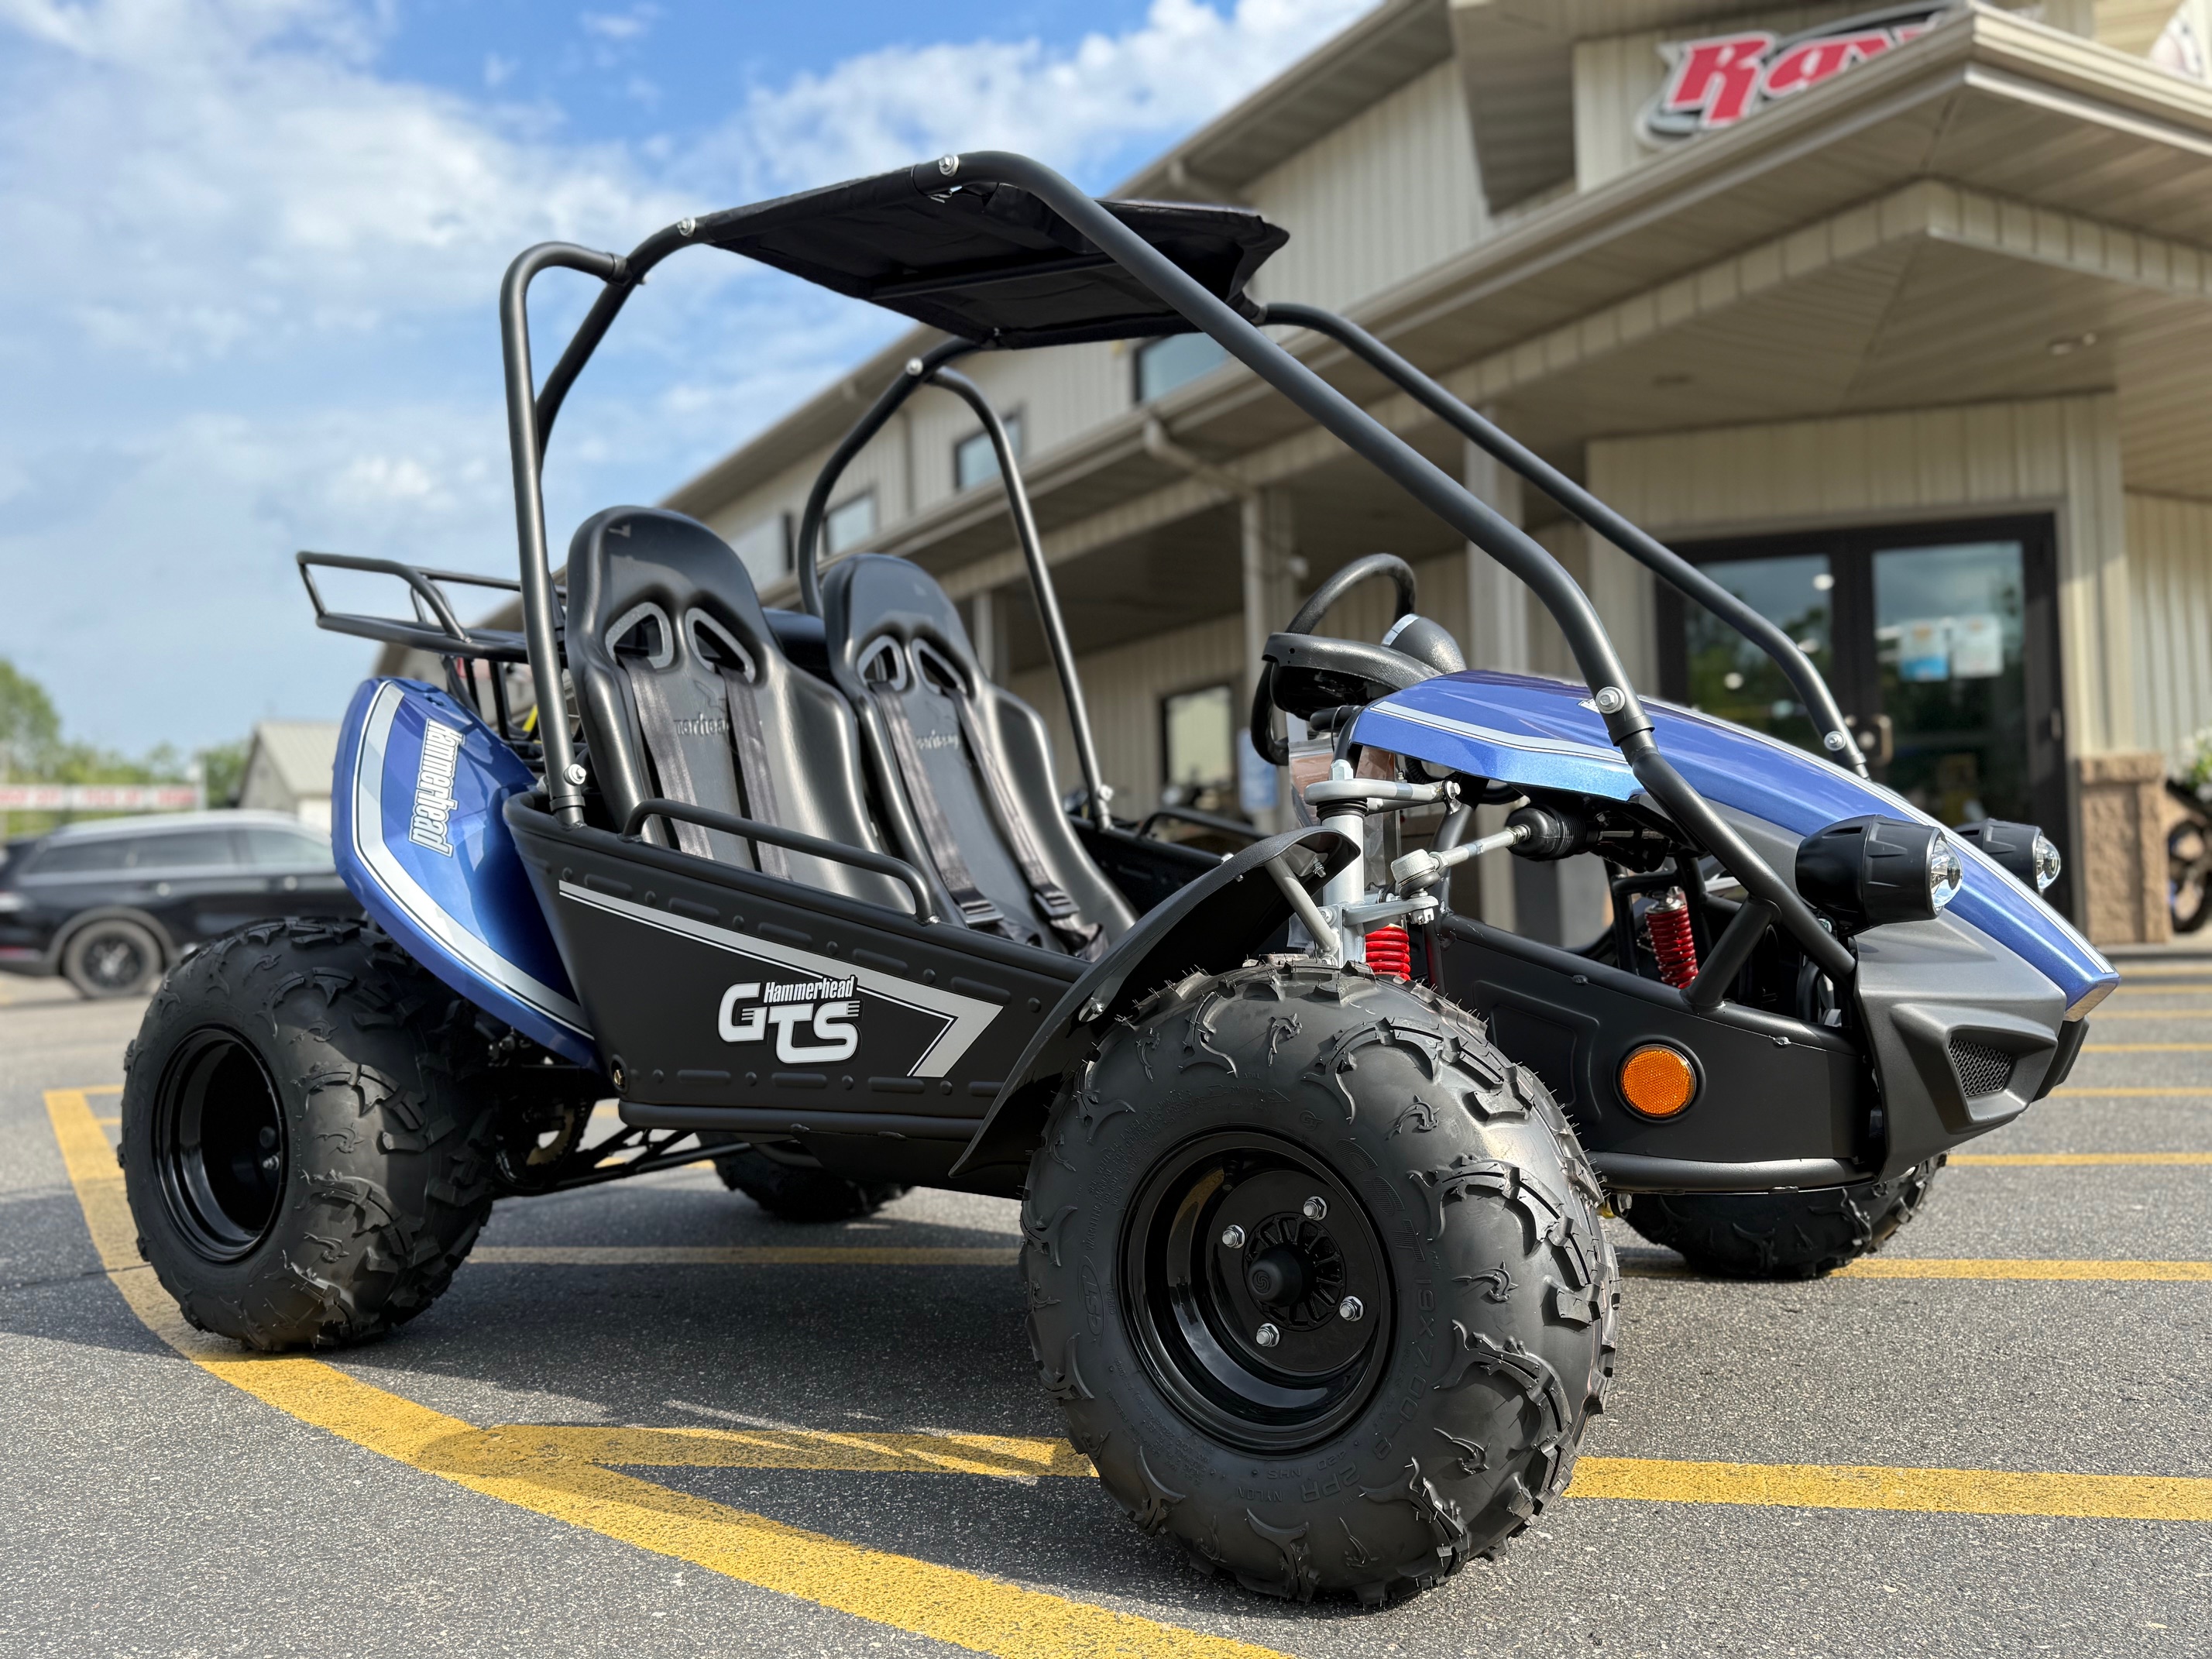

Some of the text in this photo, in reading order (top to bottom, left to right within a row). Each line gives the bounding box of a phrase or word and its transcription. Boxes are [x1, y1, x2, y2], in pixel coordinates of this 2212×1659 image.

[410, 719, 464, 857] Hammerhead
[763, 975, 855, 1004] Hammerhead
[718, 982, 861, 1064] GTS
[1336, 1139, 1425, 1262] CST
[1086, 1201, 1103, 1251] WARNING
[1235, 1486, 1283, 1503] NYLON
[1266, 1468, 1302, 1480] NHS
[1300, 1462, 1361, 1503] 2PR
